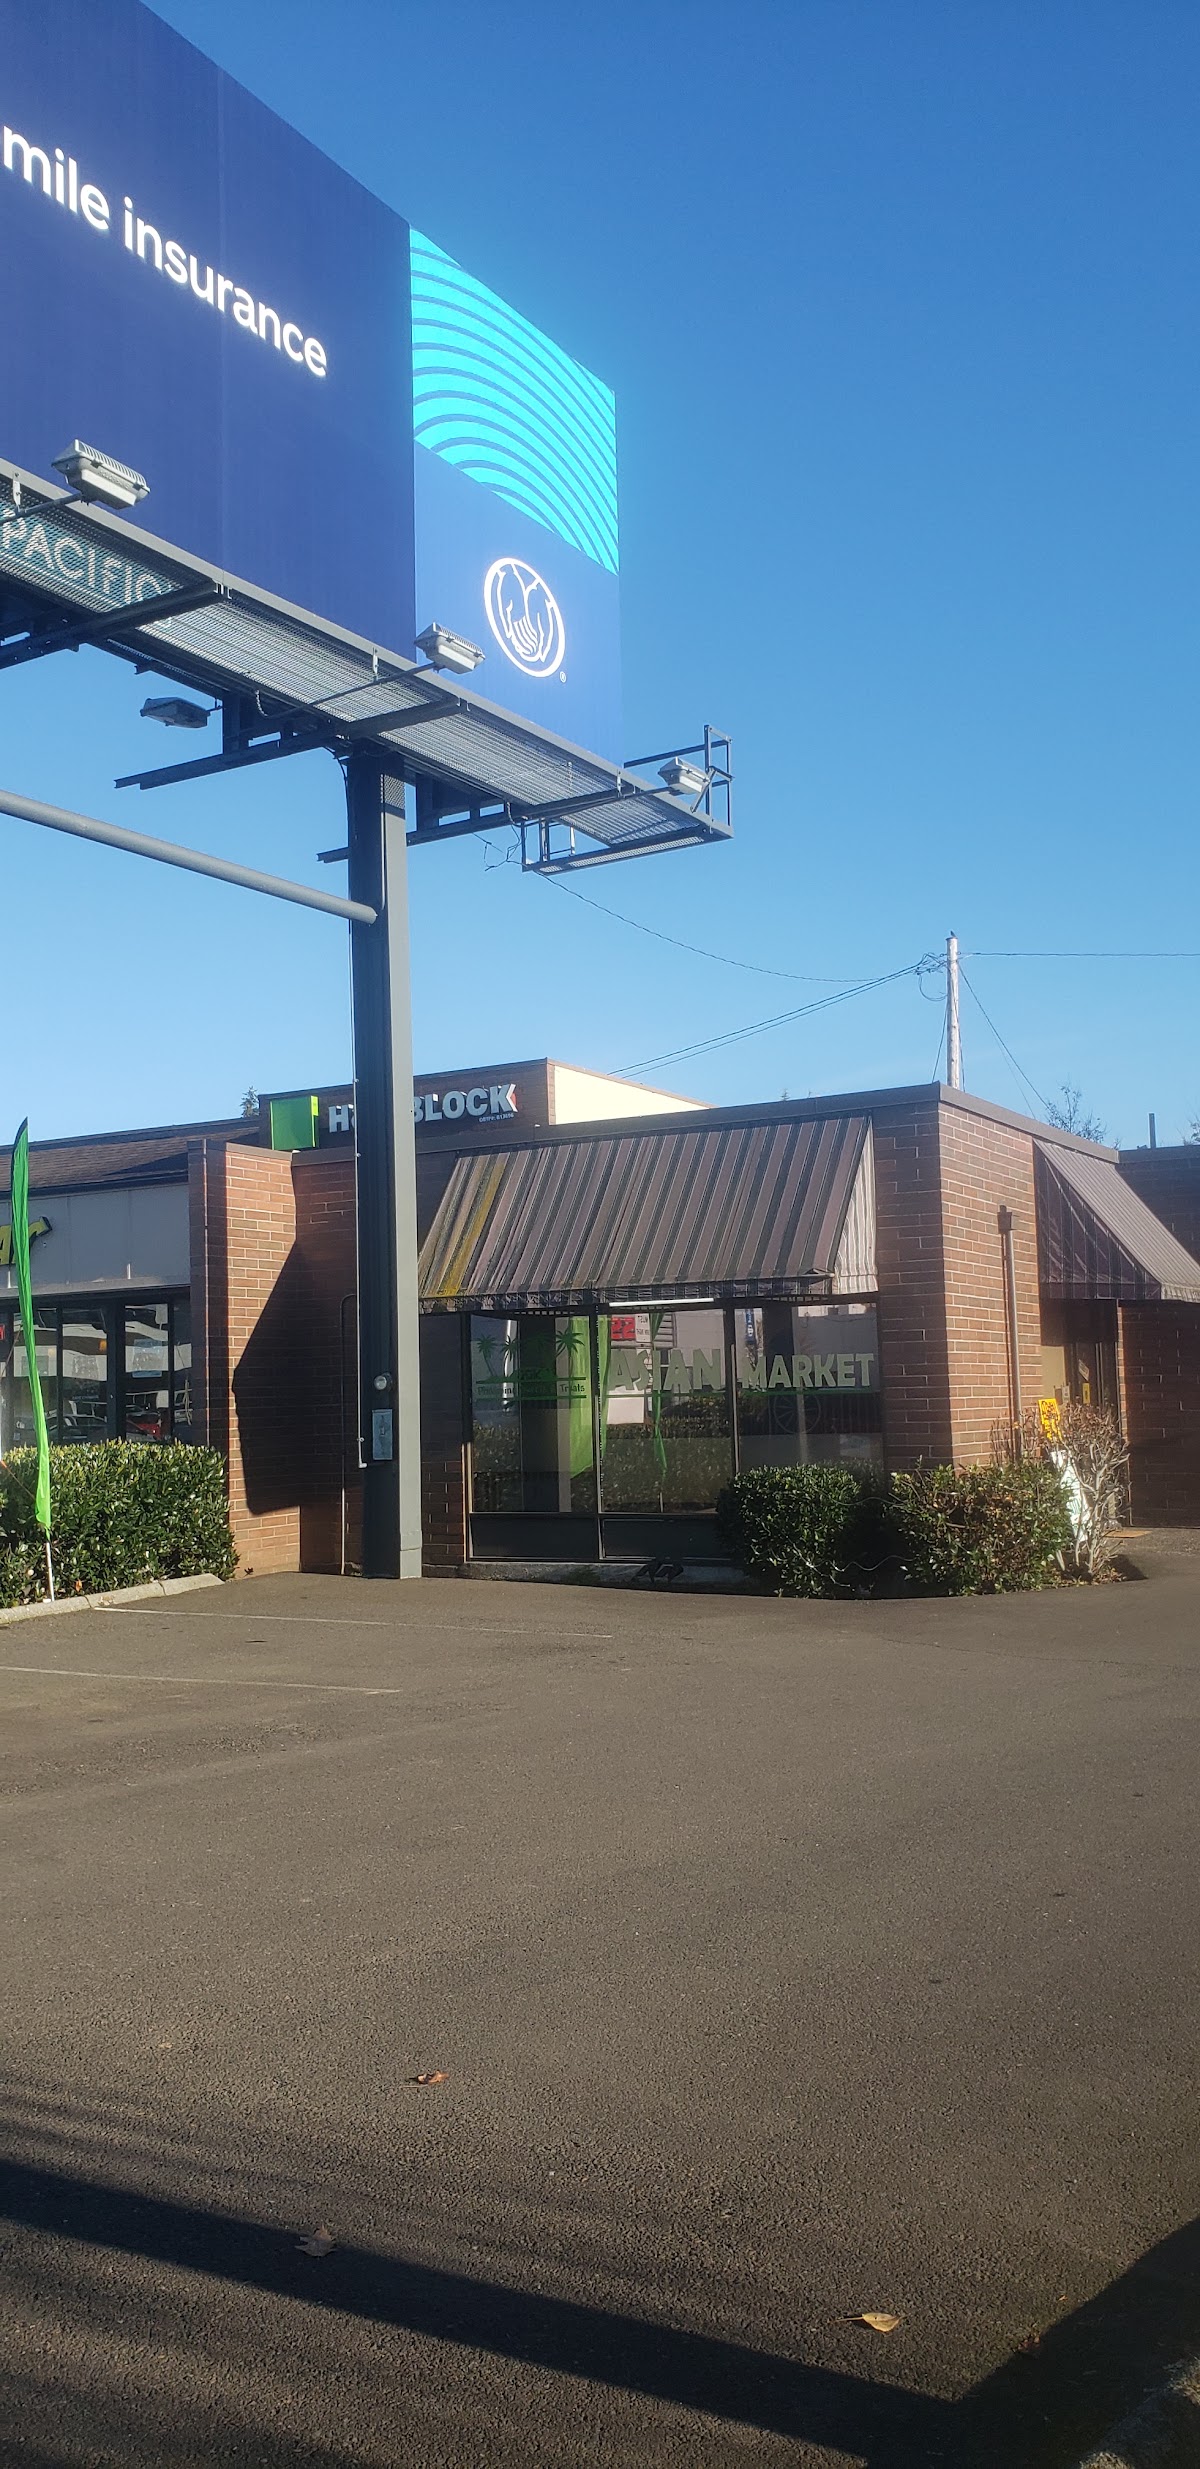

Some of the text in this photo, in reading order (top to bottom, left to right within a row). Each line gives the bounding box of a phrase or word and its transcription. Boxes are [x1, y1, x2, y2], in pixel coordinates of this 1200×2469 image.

[3, 125, 328, 377] mile insurance
[559, 1383, 586, 1393] Trats
[607, 1348, 874, 1393] ASIAN MARKET
